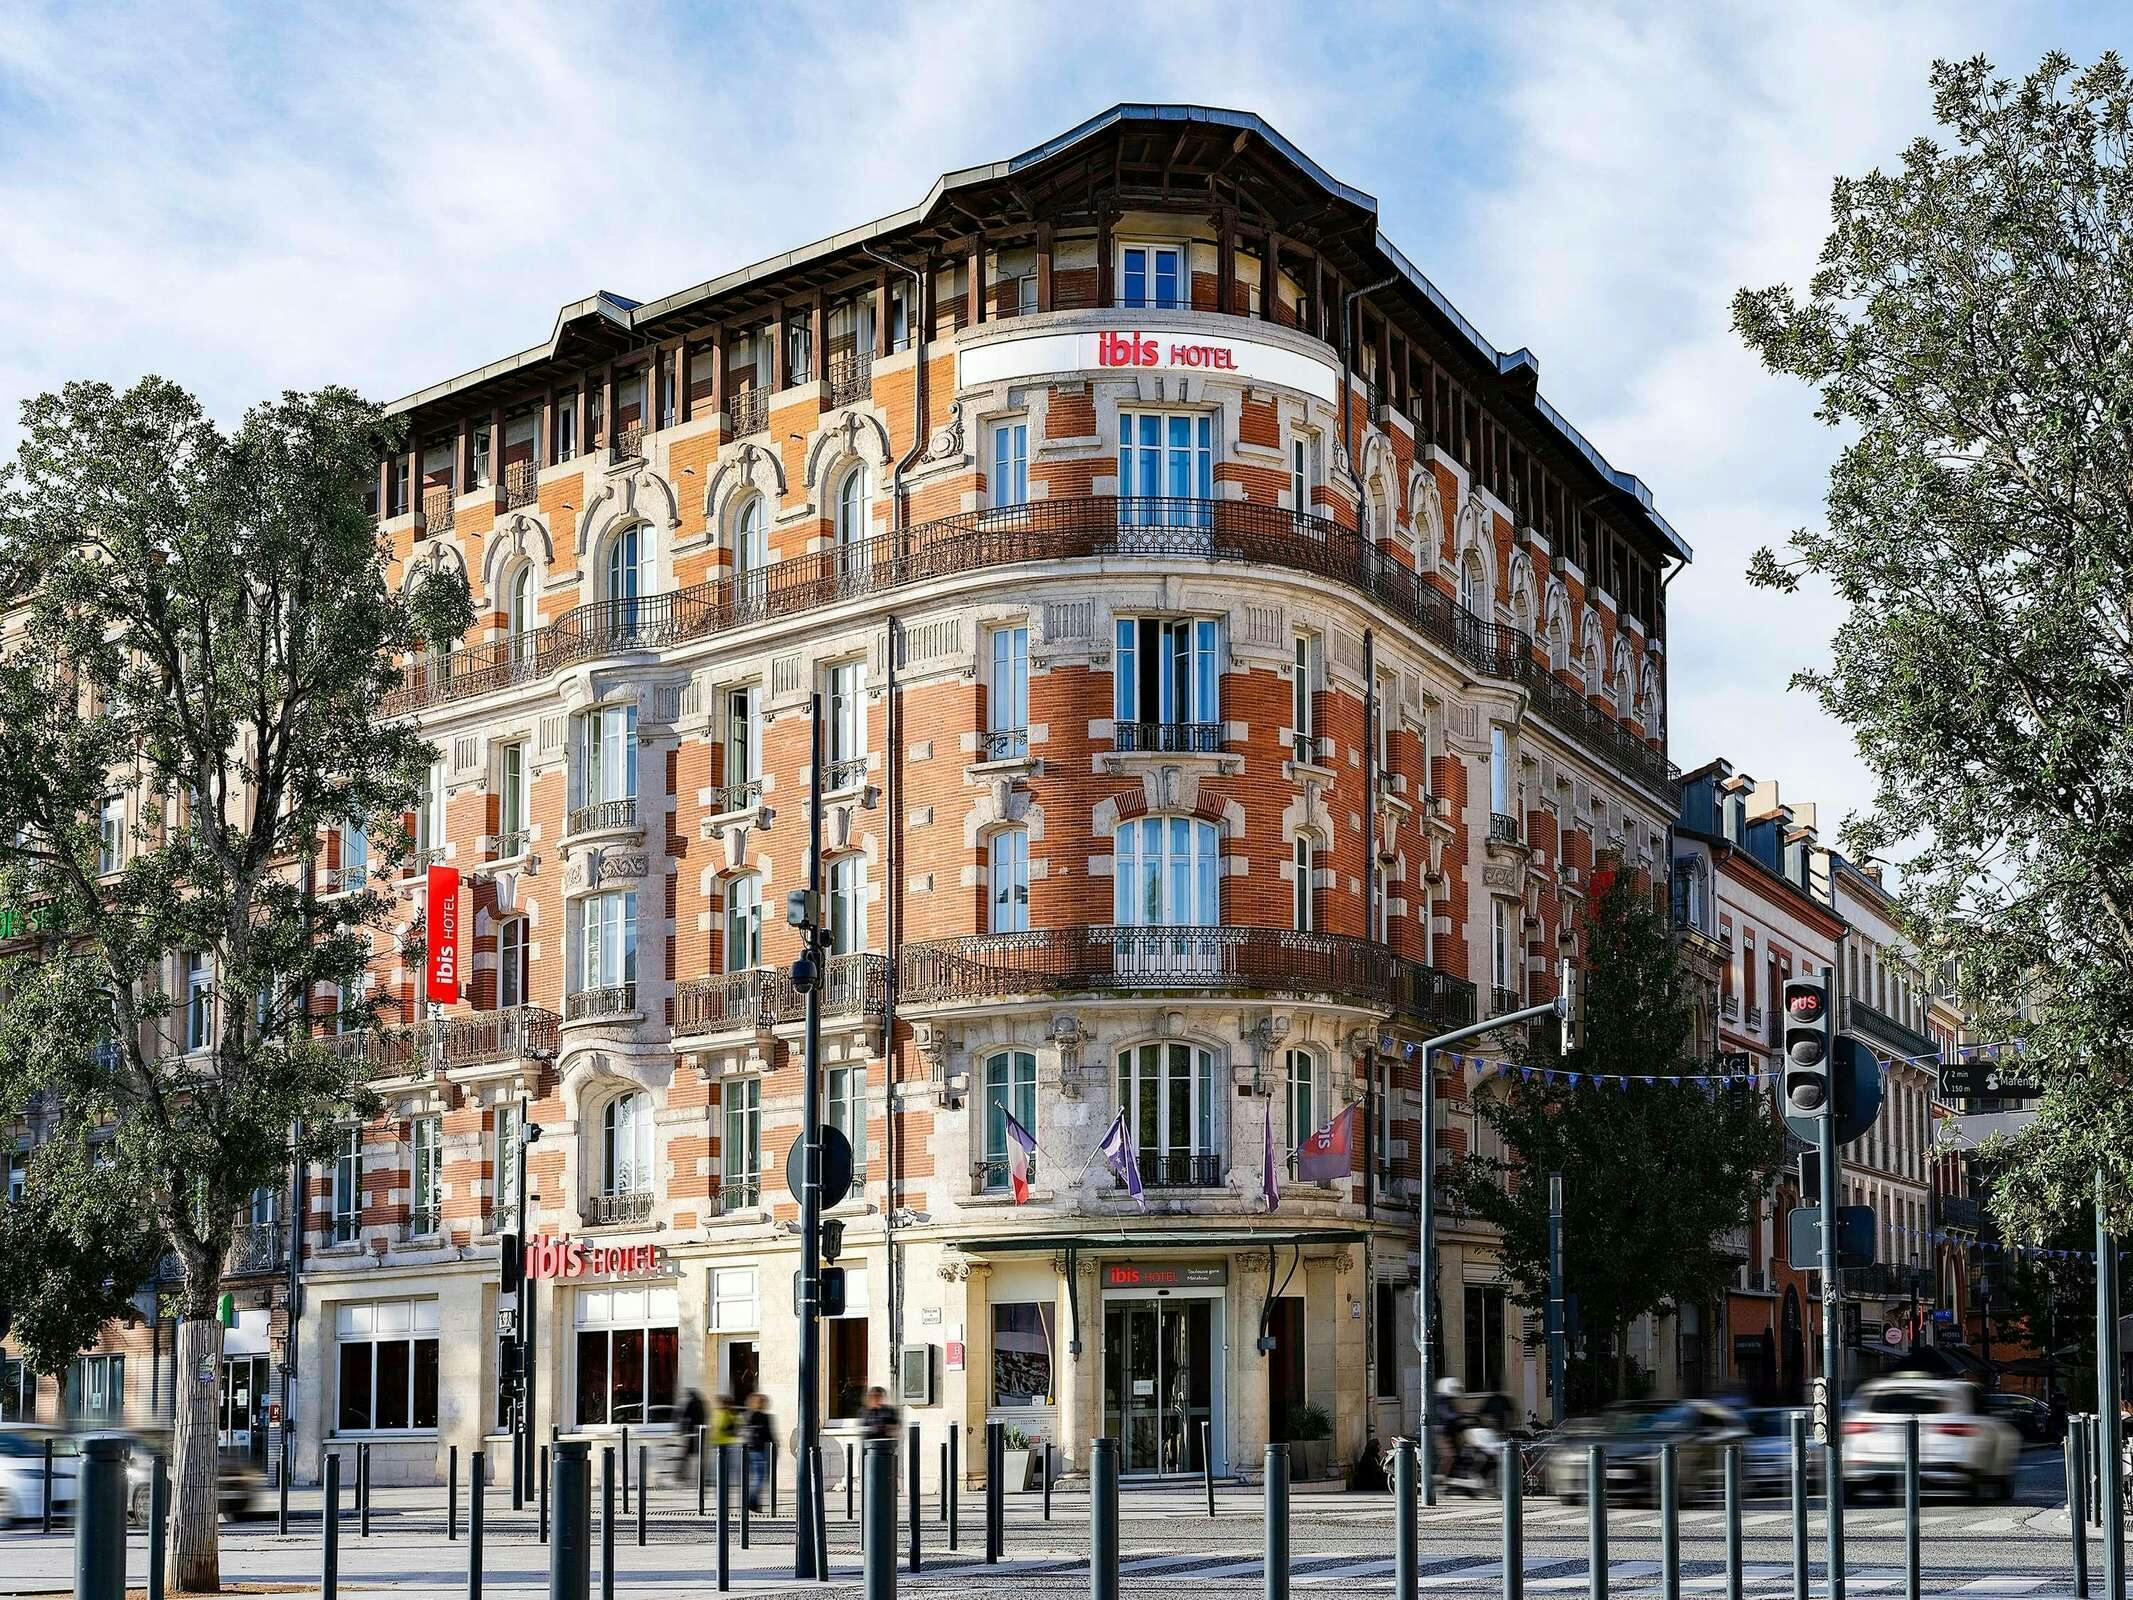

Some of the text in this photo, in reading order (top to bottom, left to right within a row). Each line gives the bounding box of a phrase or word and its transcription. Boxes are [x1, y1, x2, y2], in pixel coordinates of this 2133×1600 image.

[1099, 331, 1239, 370] ibis HOTEL
[436, 894, 455, 985] ibis HOTEL
[1957, 1070, 1969, 1078] min
[1951, 1084, 1963, 1093] 150
[525, 1233, 662, 1279] ibis HOTEL
[1111, 1266, 1177, 1283] ibis HOTEL
